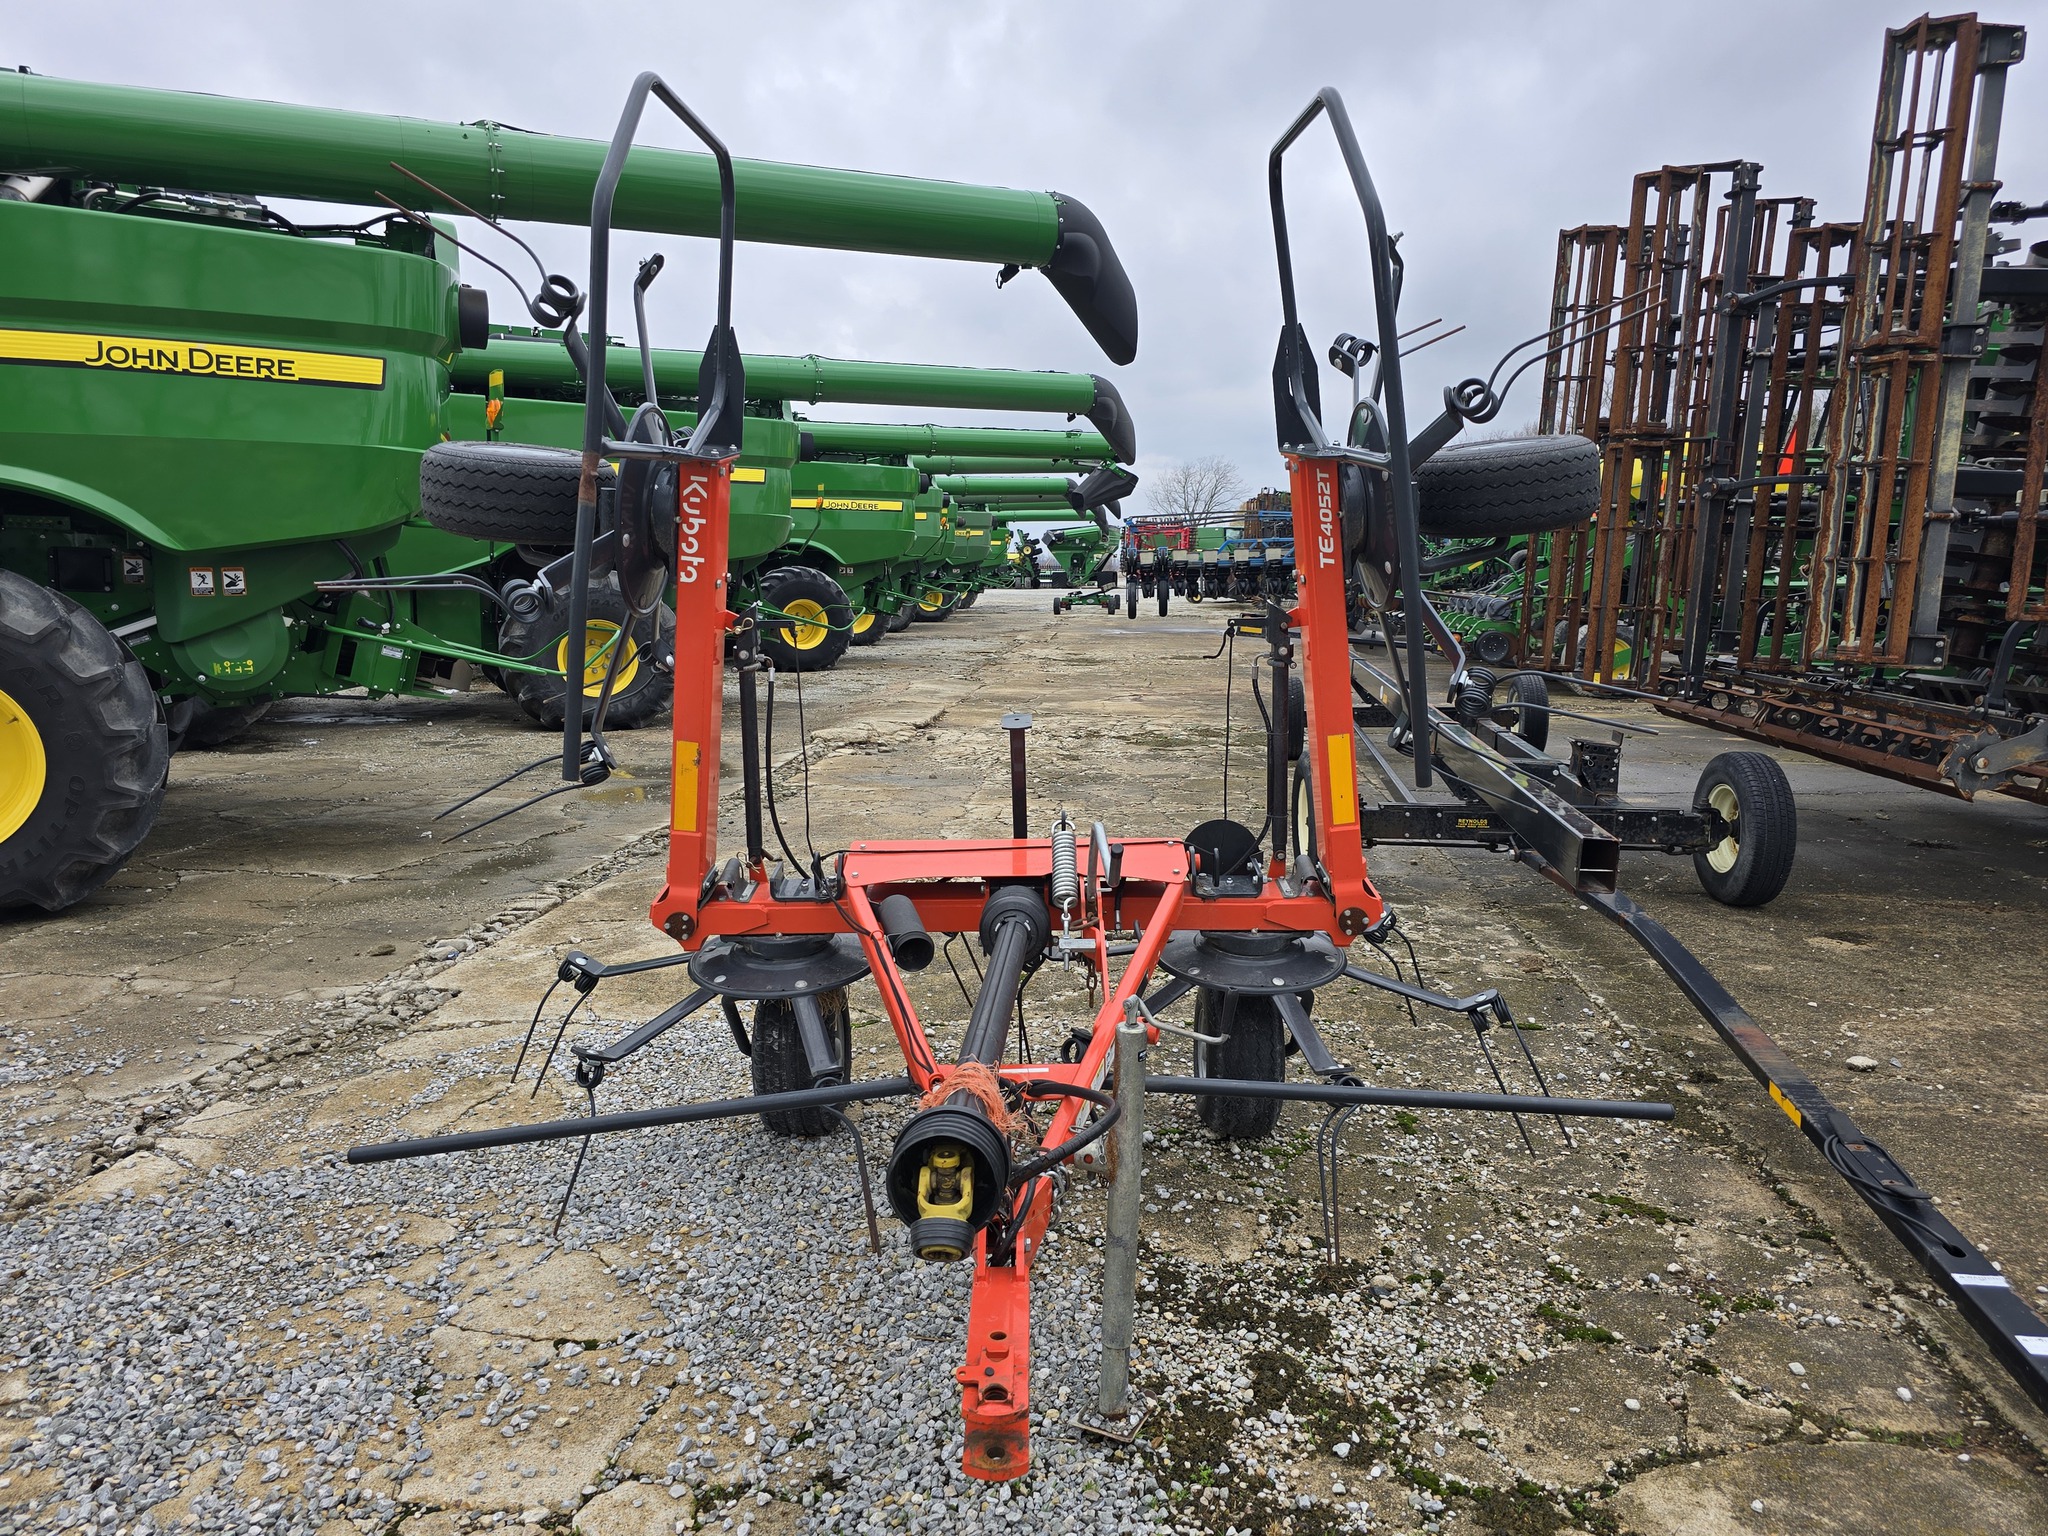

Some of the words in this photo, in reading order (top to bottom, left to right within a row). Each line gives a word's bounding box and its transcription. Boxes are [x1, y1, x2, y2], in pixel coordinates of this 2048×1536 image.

[85, 340, 179, 368] JOHN
[188, 347, 296, 378] DEERE
[679, 475, 709, 584] Kubota
[825, 500, 849, 509] JOHN
[850, 501, 879, 510] DEERE
[1316, 467, 1336, 569] TE4052T
